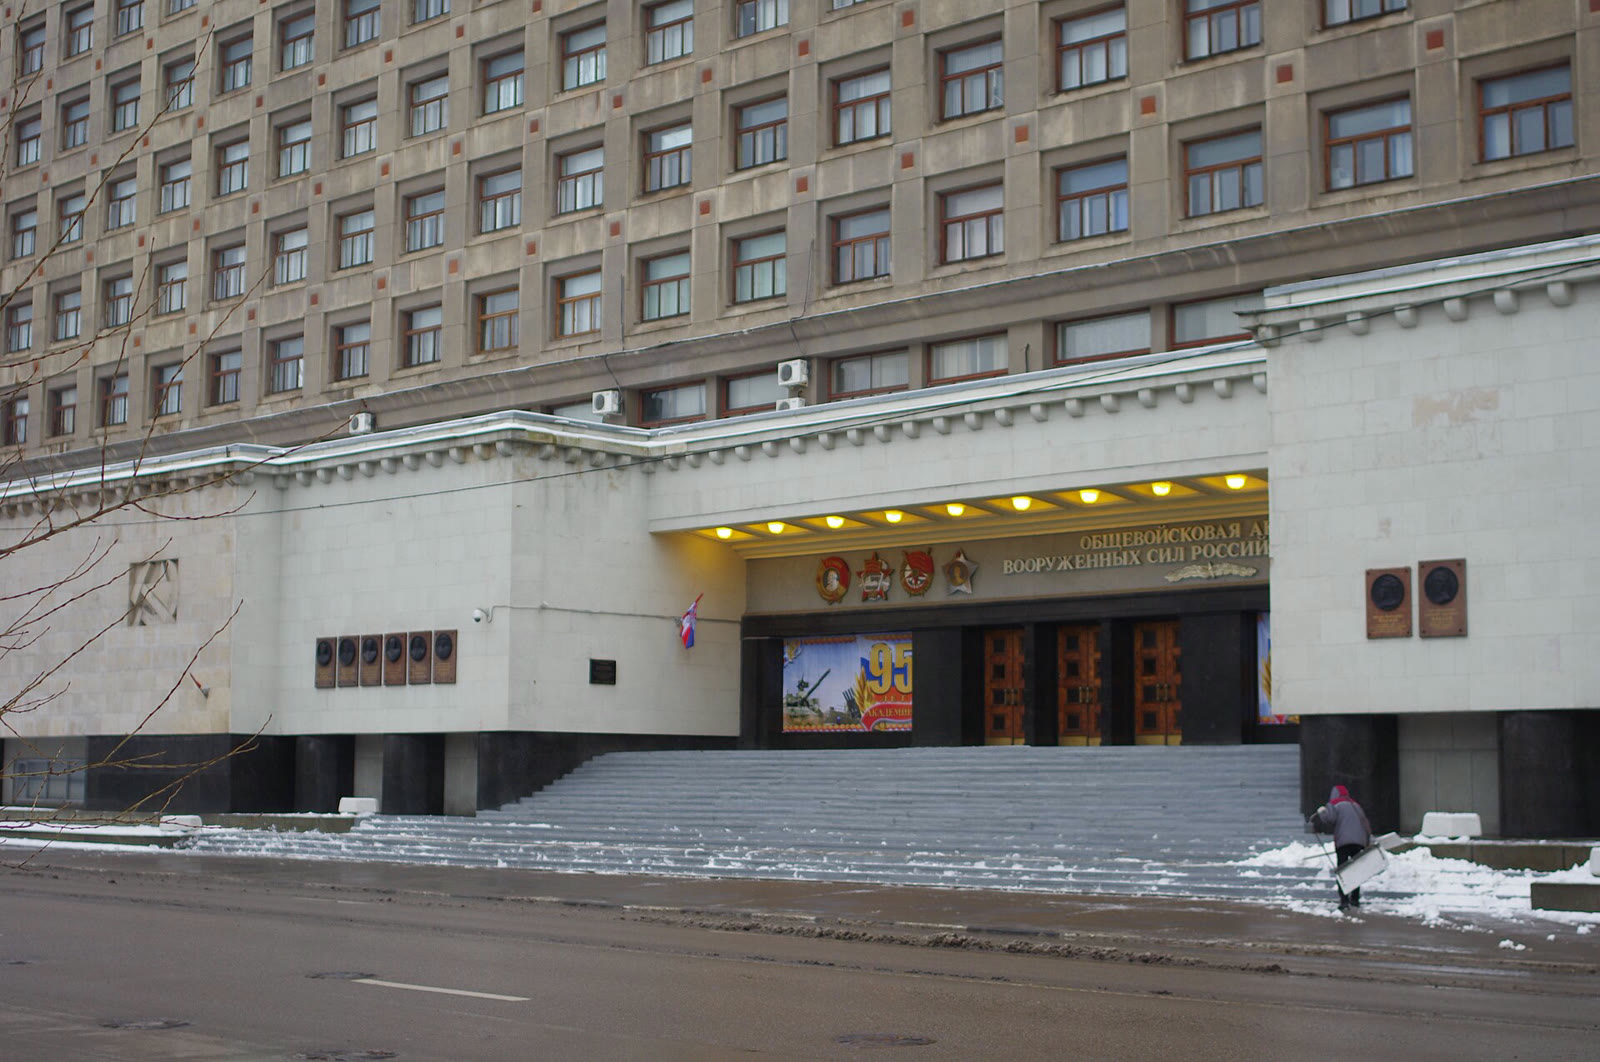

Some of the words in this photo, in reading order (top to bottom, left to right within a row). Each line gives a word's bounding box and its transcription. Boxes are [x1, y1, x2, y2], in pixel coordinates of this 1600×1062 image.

[1080, 523, 1240, 550] ОБЩЕВОЙСКОВАЯ
[1003, 550, 1141, 574] ВООРУЖЕННЫХ
[1147, 547, 1185, 564] СИЛ
[869, 642, 912, 694] 95
